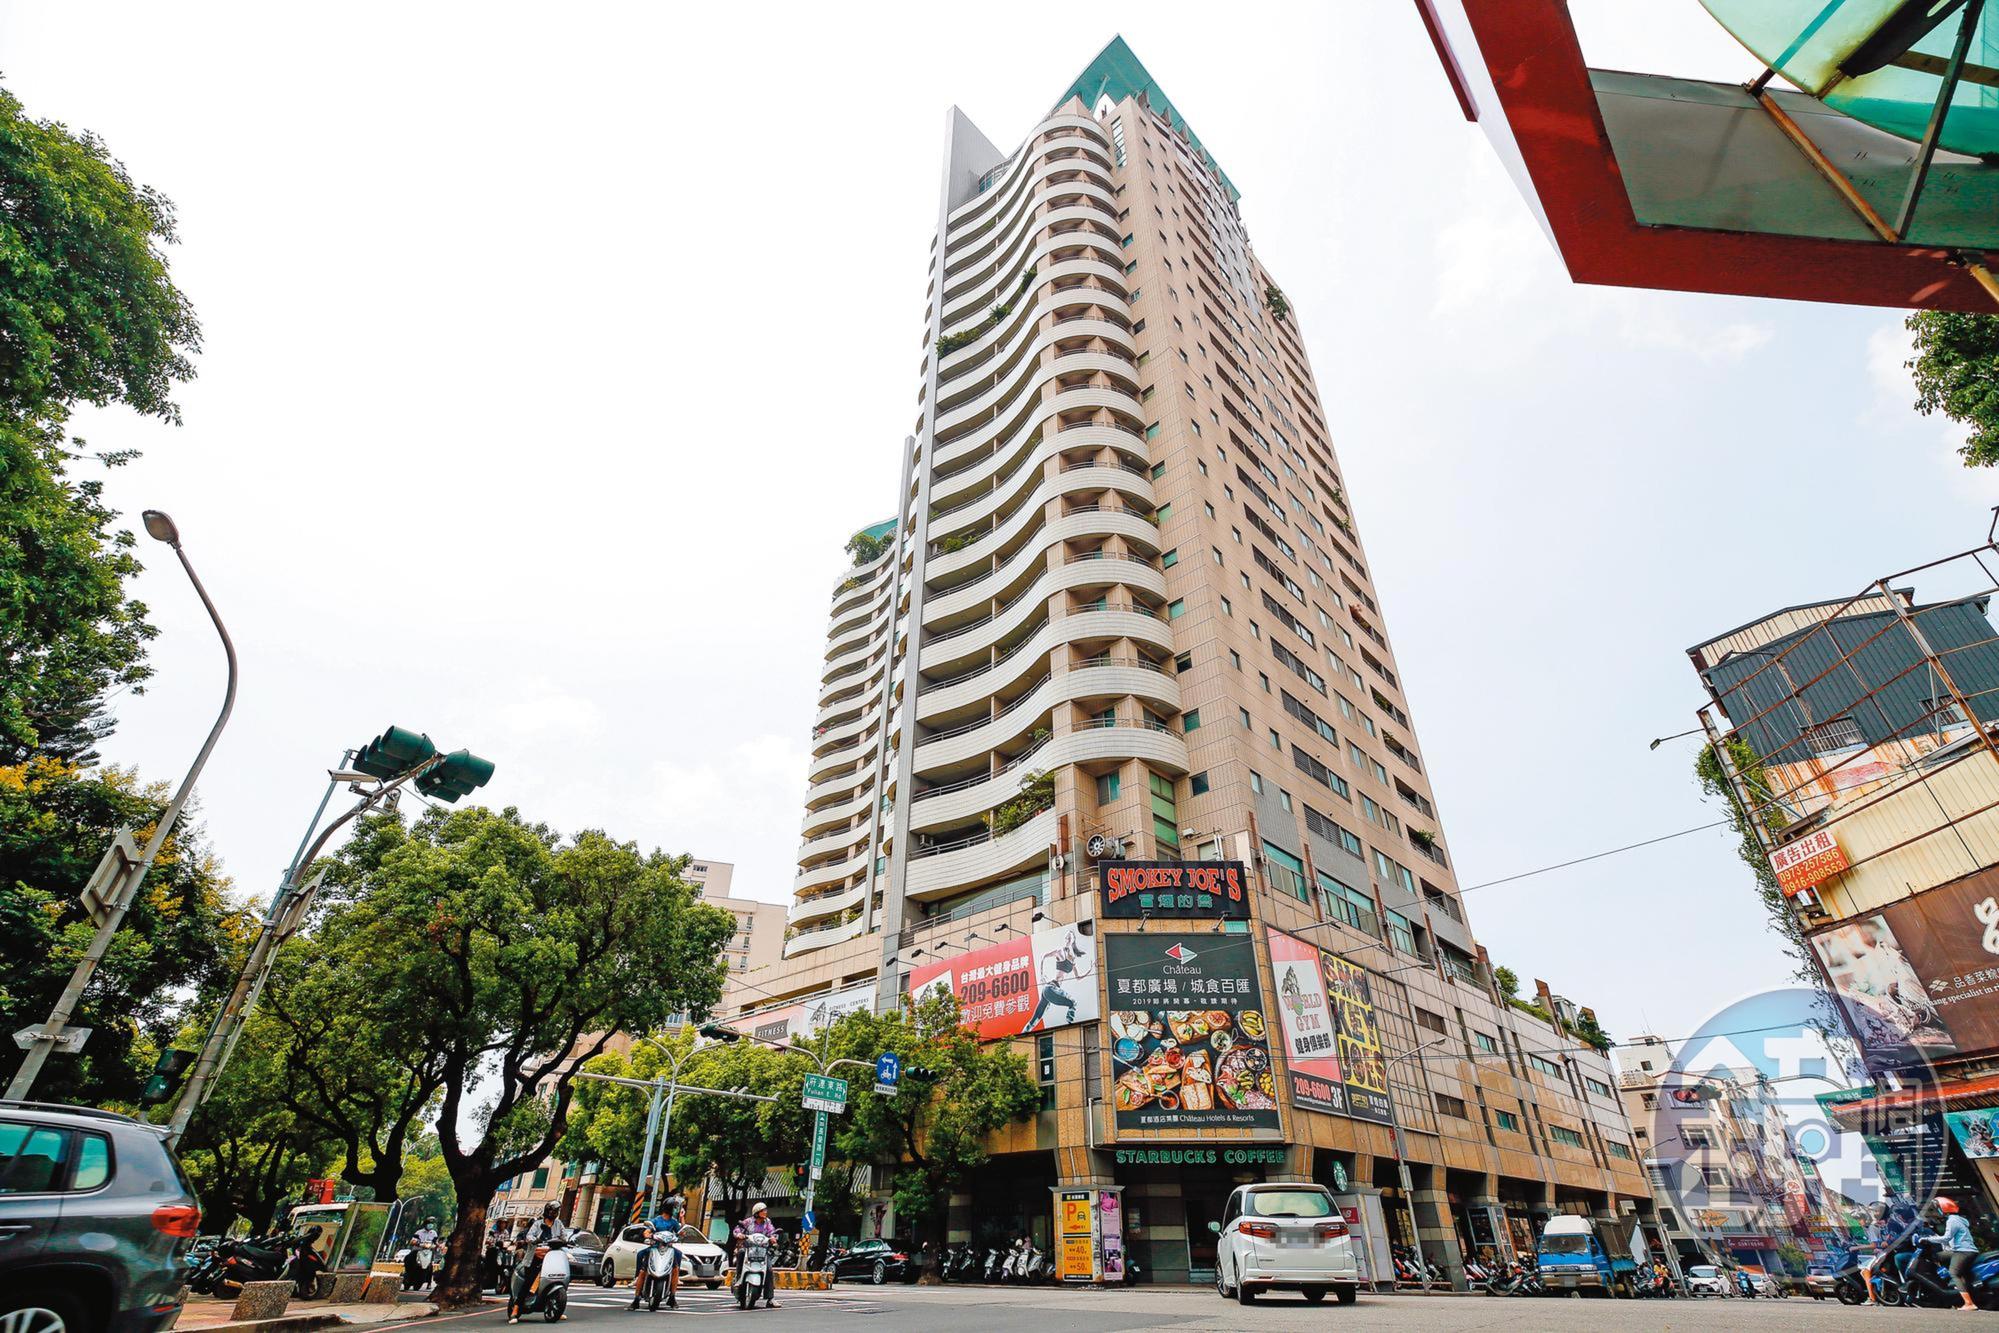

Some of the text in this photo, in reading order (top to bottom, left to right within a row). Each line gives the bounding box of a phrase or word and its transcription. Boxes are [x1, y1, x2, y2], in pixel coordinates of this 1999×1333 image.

[1773, 831, 1833, 870] 廣告出租
[1779, 848, 1840, 882] 0973-257586
[1107, 867, 1242, 903] SMOKEY JOE'S
[1784, 860, 1845, 894] 0916-908553
[1162, 965, 1202, 975] Château
[960, 970, 1030, 1006] 209-6600
[1117, 978, 1177, 994] 夏都廣場
[1948, 987, 1984, 1003] specialist
[1984, 985, 1993, 994] in
[757, 1024, 785, 1038] FITNESS
[1295, 1013, 1321, 1033] GYM
[1294, 1076, 1332, 1101] 209-6600
[1331, 1086, 1343, 1109] 3F
[1206, 1114, 1225, 1122] Hotels
[1232, 1114, 1255, 1122] Resorts
[1115, 1150, 1286, 1164] STARBUCKS COFFEE
[1066, 1203, 1077, 1221] P
